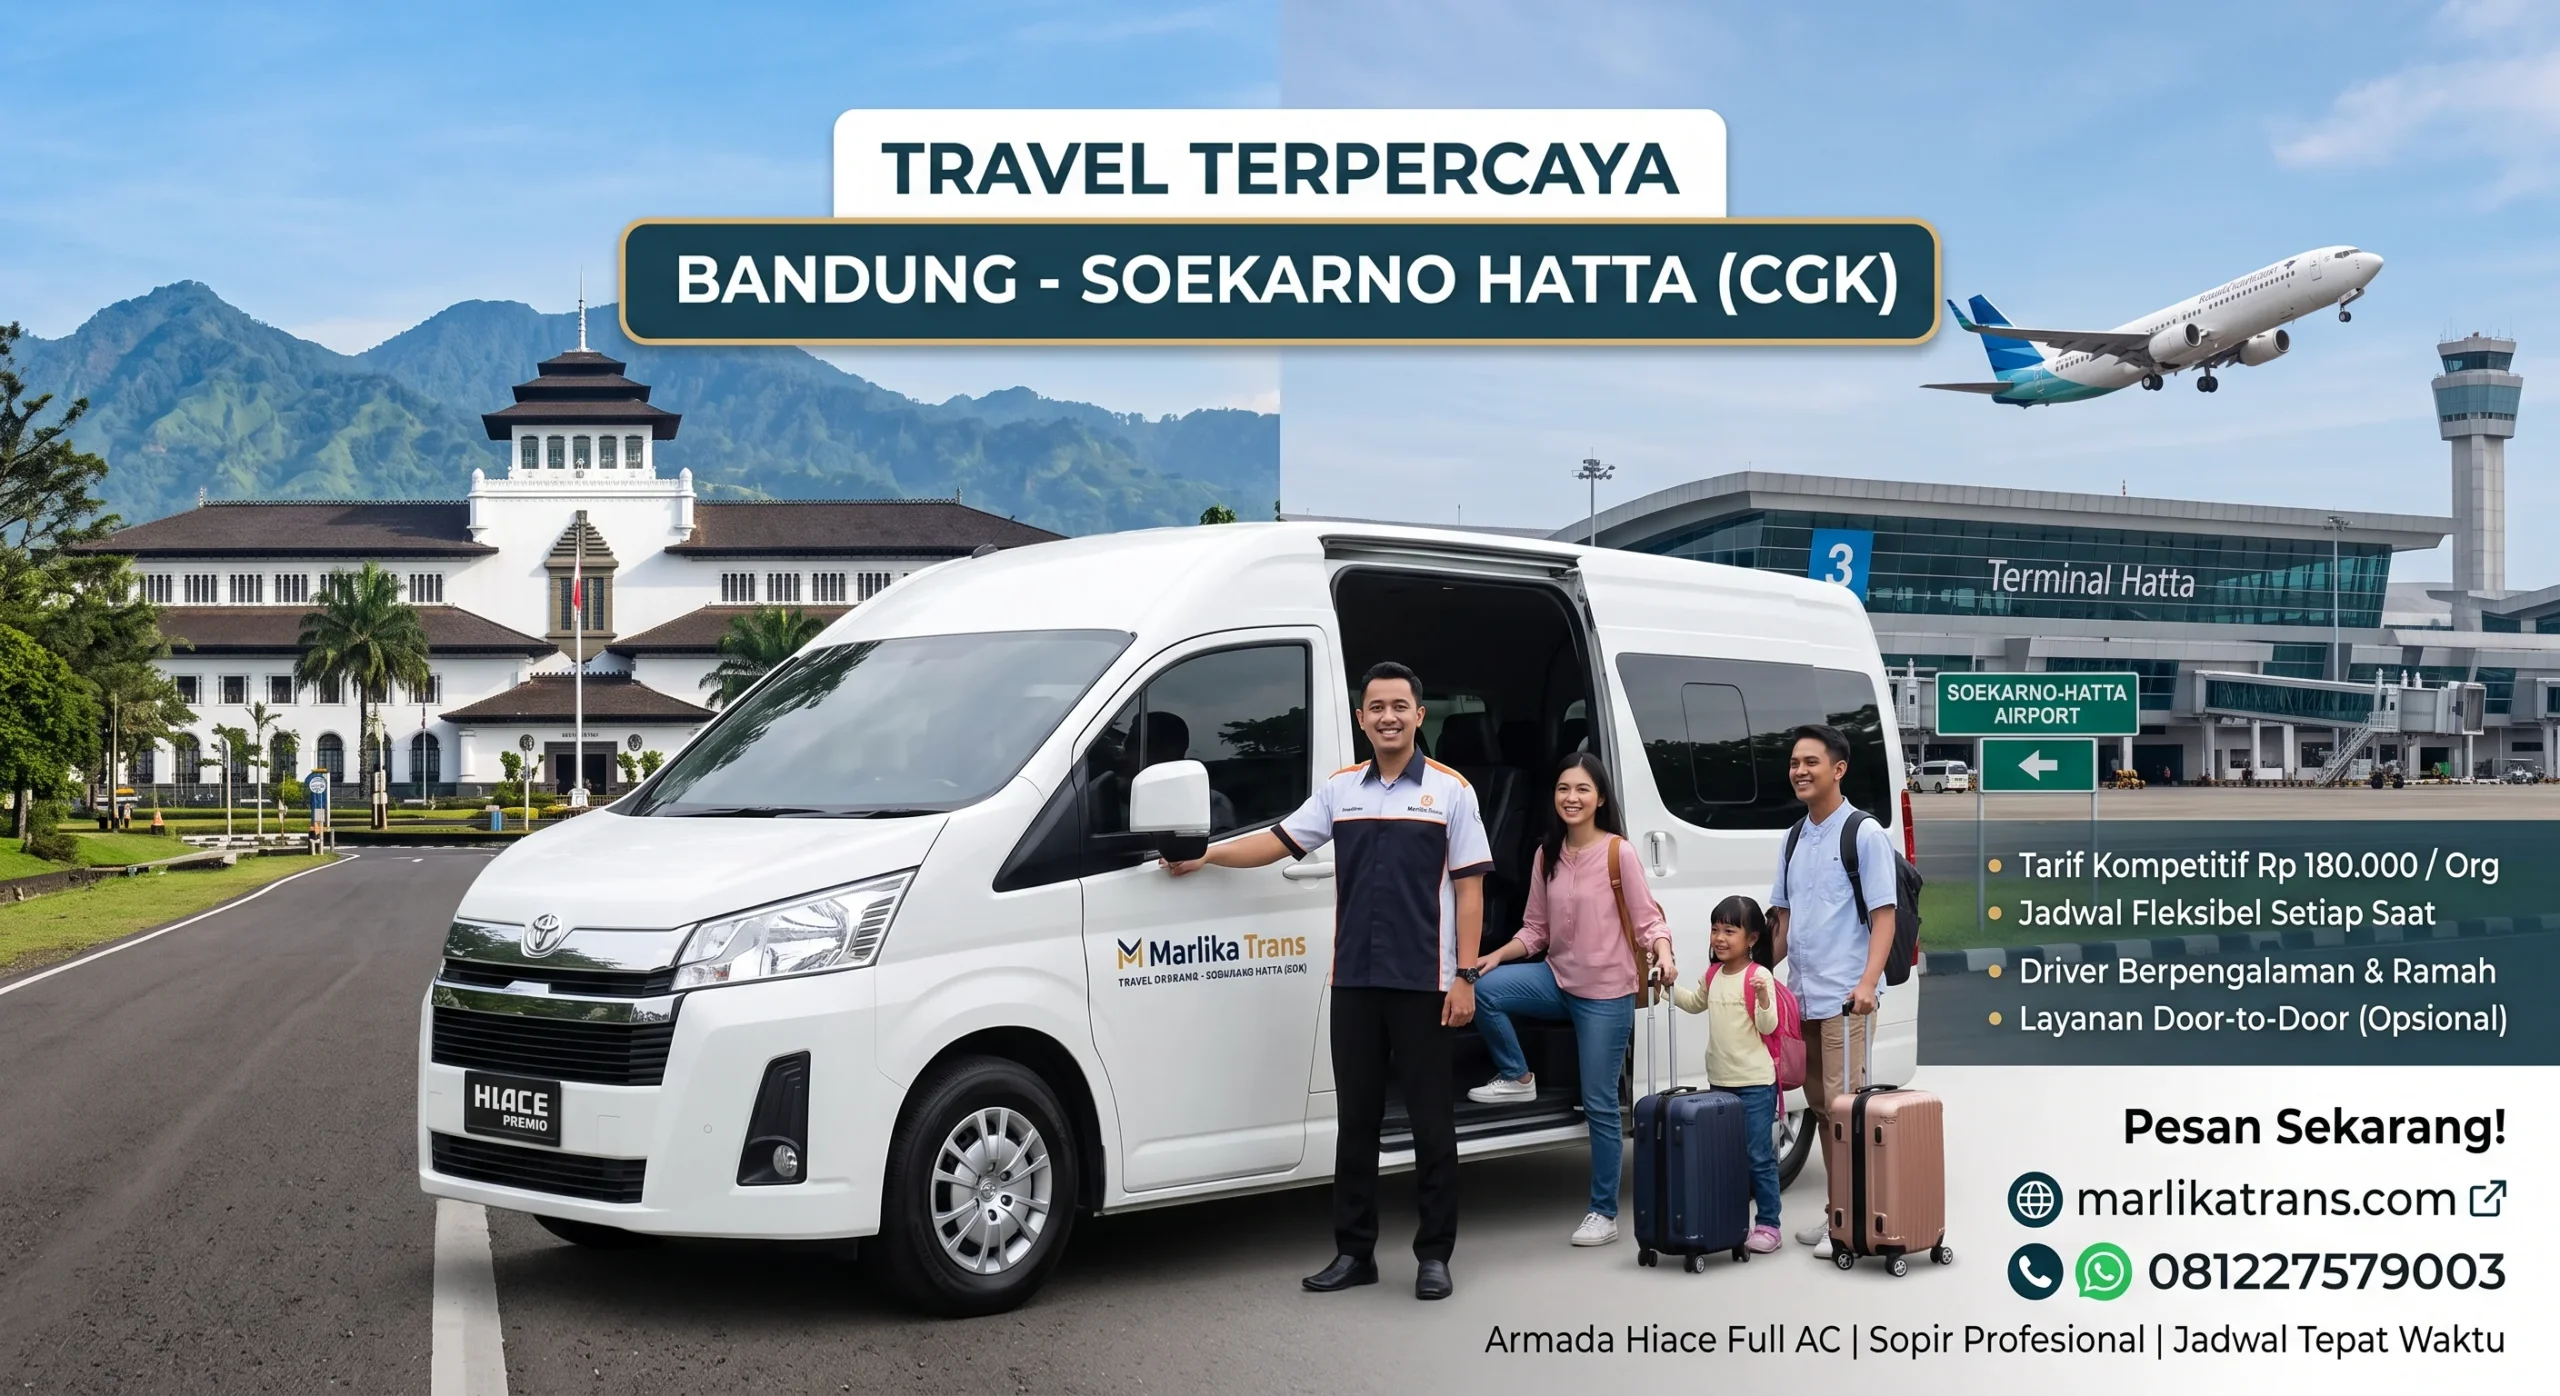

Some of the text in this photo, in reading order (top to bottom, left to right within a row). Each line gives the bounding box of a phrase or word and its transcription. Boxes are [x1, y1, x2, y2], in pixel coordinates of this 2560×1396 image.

[1825, 543, 1854, 588] 3
[1988, 559, 2195, 598] Terminal Hatta
[1947, 683, 2128, 702] SOEKARNO-HATTA
[1994, 706, 2081, 725] AIRPORT
[1150, 935, 1240, 967] Marlika
[1244, 934, 1306, 959] Trans
[1118, 976, 1153, 988] TRAVEL
[1255, 964, 1283, 976] HATTA
[474, 1083, 549, 1117] HIACE
[503, 1114, 548, 1132] PREMIO
